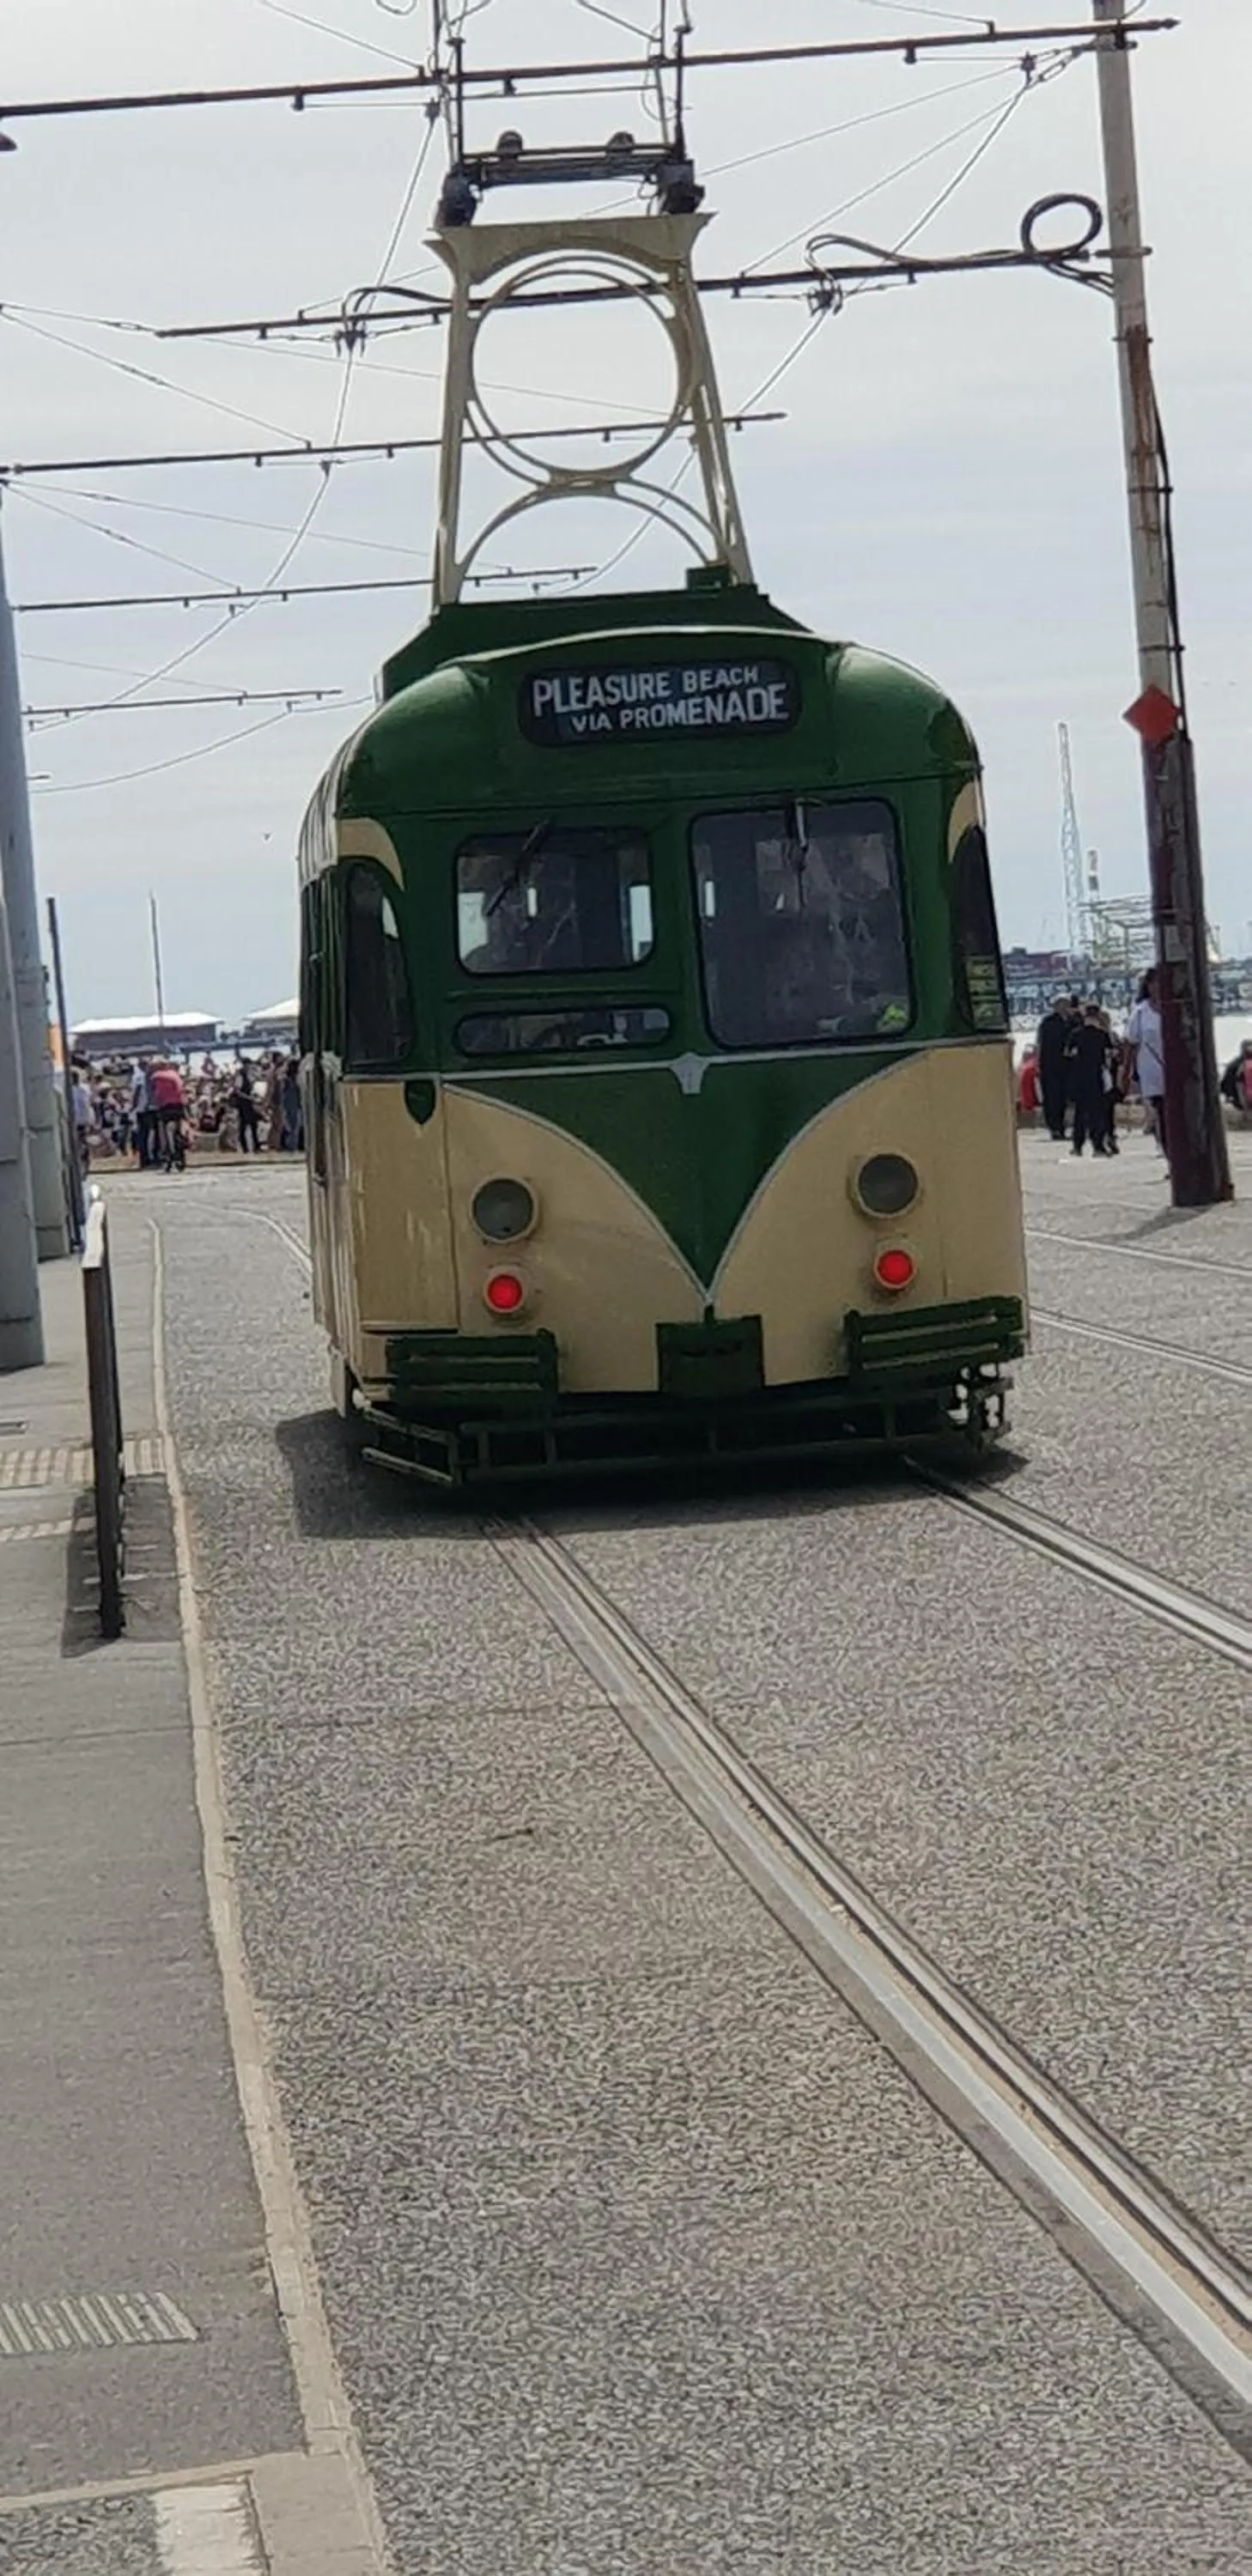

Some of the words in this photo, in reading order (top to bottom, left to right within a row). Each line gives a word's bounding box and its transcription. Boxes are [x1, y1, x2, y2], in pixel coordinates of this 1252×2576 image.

[532, 671, 672, 716] PLEASURE
[682, 666, 759, 693] BEACH
[571, 714, 613, 732] VIA
[620, 683, 789, 729] PROMENADE
